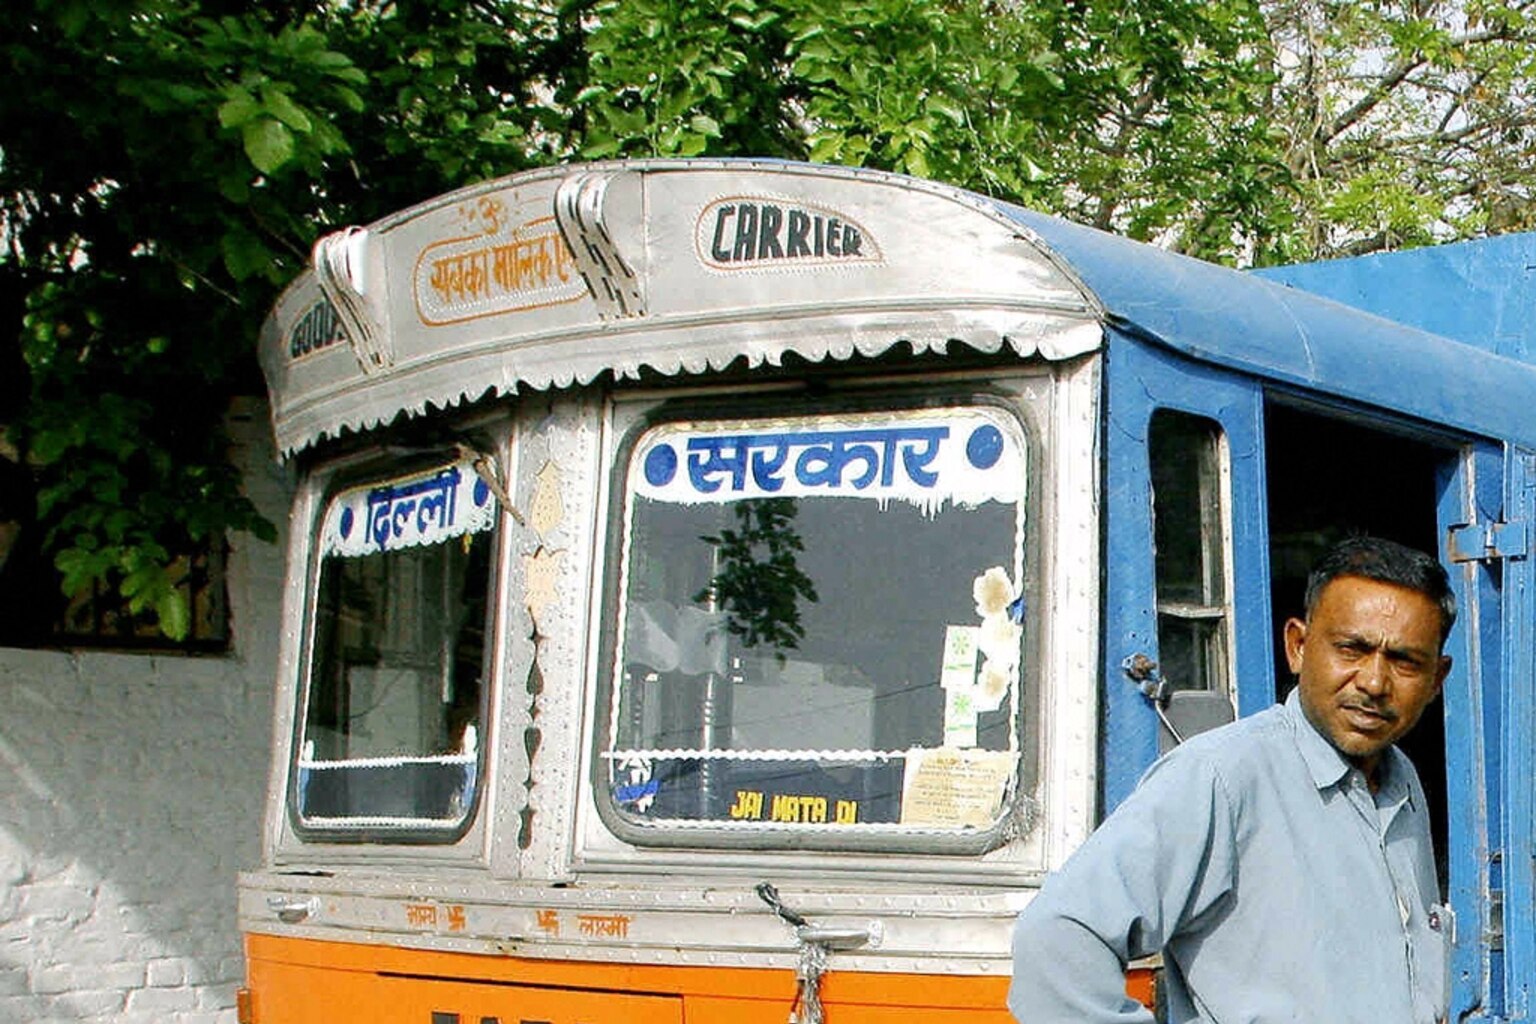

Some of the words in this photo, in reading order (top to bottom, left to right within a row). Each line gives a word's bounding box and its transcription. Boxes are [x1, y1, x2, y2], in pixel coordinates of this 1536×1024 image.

[712, 203, 862, 262] CARRIER
[291, 301, 345, 358] GOOD
[687, 427, 950, 493] सरकार
[365, 465, 461, 551] दिल्ली
[731, 791, 763, 819] JAI
[772, 795, 827, 823] MATA
[836, 800, 858, 824] DI
